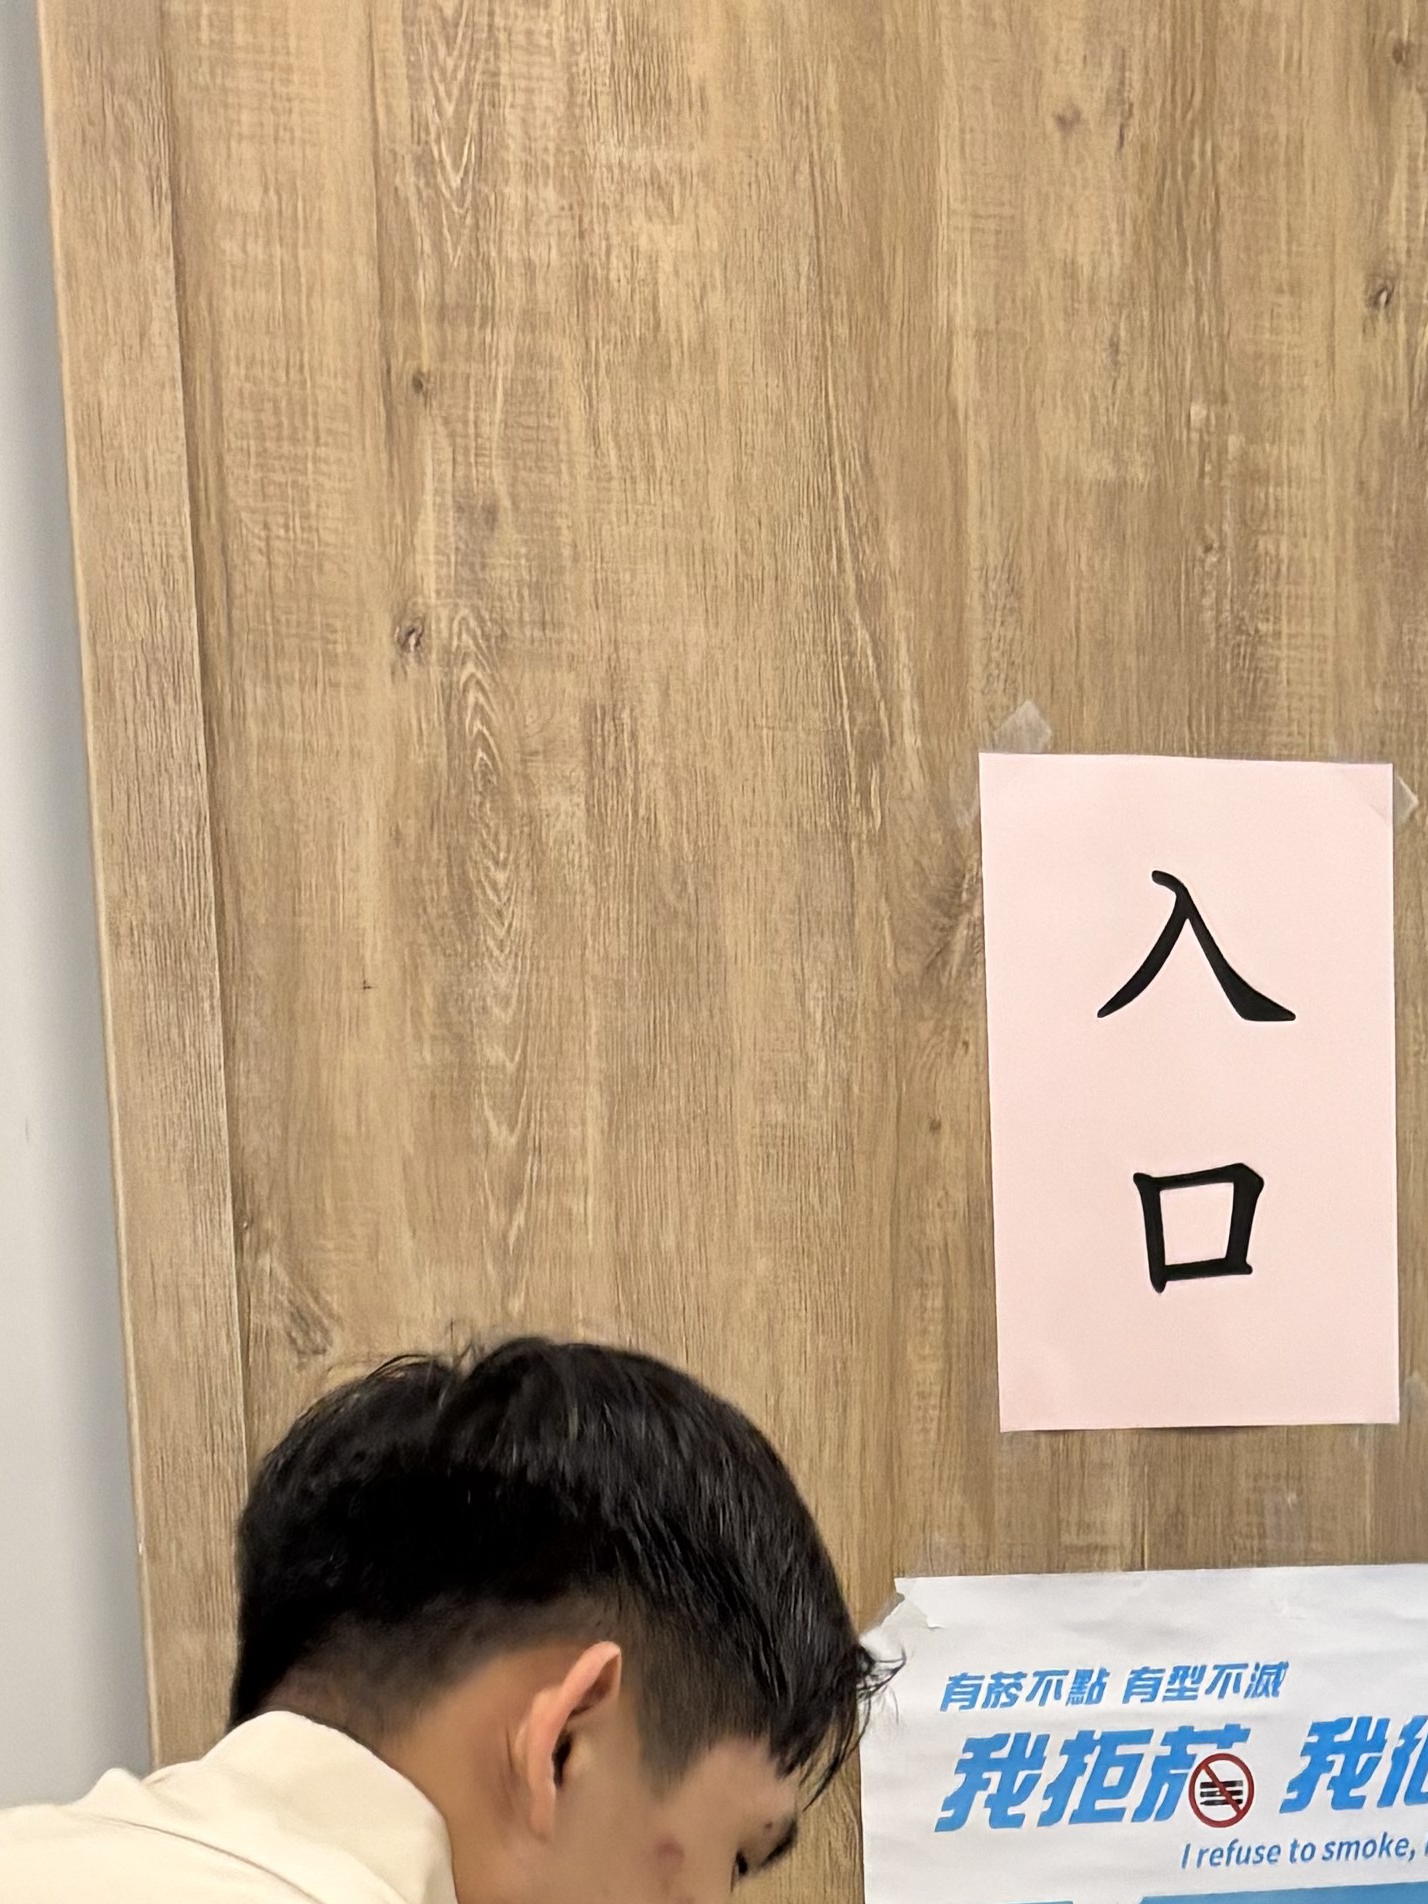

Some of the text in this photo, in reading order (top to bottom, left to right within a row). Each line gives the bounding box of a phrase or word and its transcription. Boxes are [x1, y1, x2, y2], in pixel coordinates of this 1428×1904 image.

[1096, 869, 1296, 1293] 入口
[940, 1660, 1289, 1712] 有菸不點 有型不滅
[1181, 1843, 1191, 1869] I
[1196, 1838, 1281, 1869] refuse
[1289, 1838, 1316, 1865] to
[1322, 1831, 1416, 1862] smoke,
